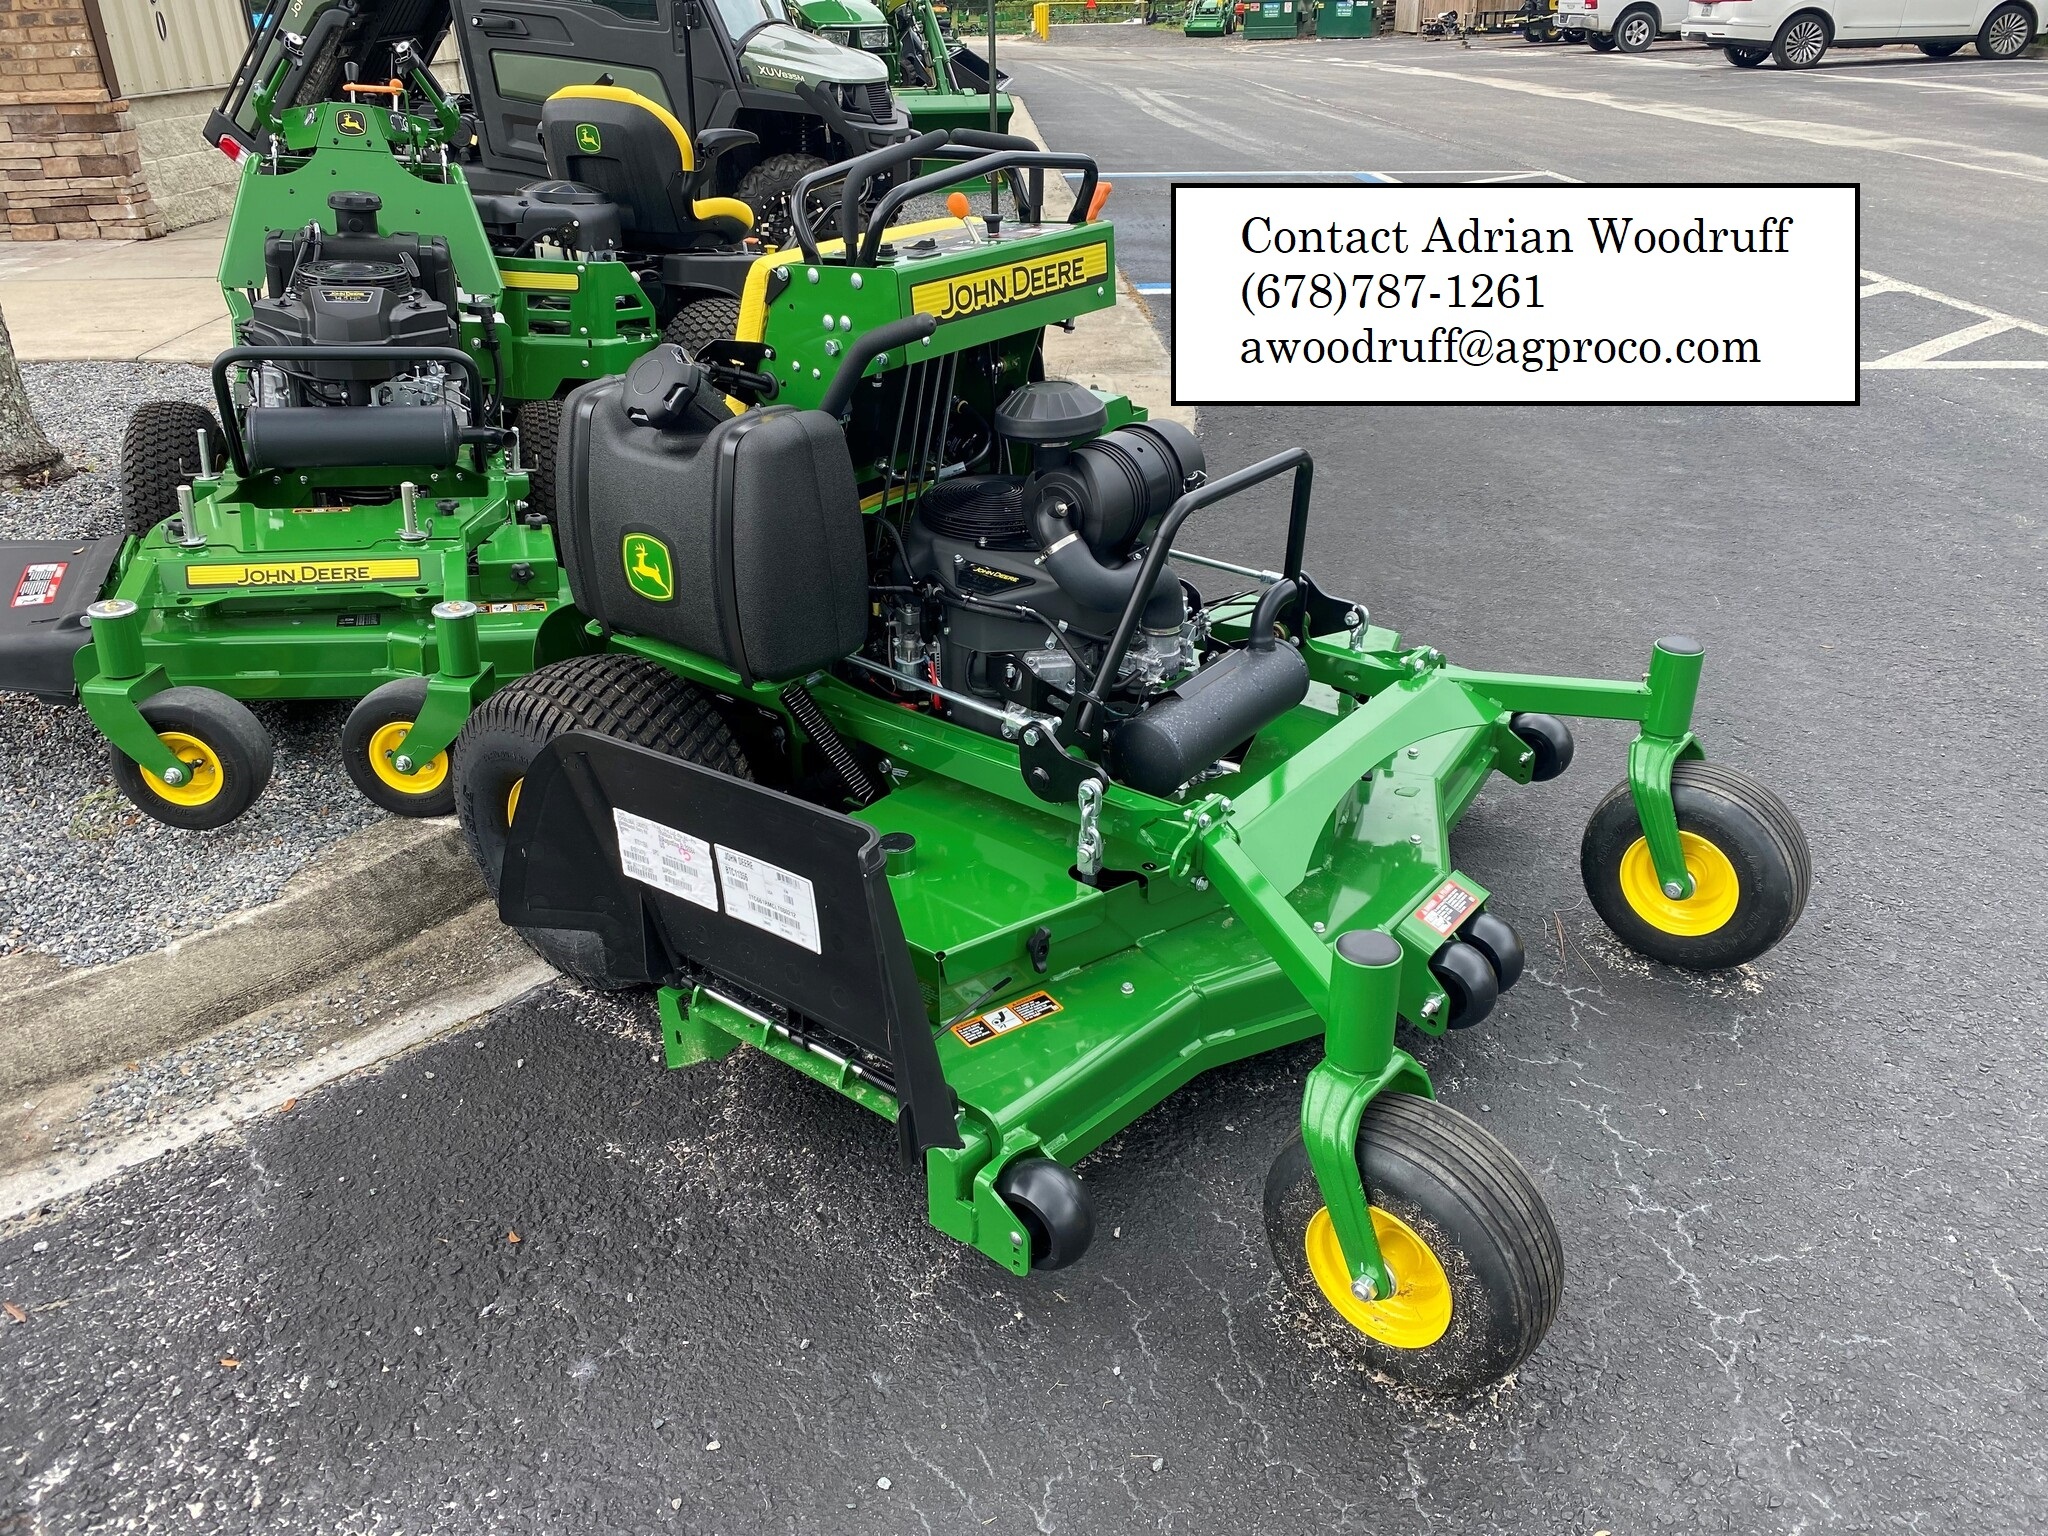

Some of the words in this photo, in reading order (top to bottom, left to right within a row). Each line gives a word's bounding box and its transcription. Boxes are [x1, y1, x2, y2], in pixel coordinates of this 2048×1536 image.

[757, 65, 805, 82] XUV835M
[941, 276, 1007, 316] JOHN
[1012, 256, 1085, 297] DEERE
[238, 568, 296, 583] JOHN
[301, 566, 370, 581] DEERE
[973, 566, 995, 577] JOHN
[993, 571, 1020, 583] DEERE
